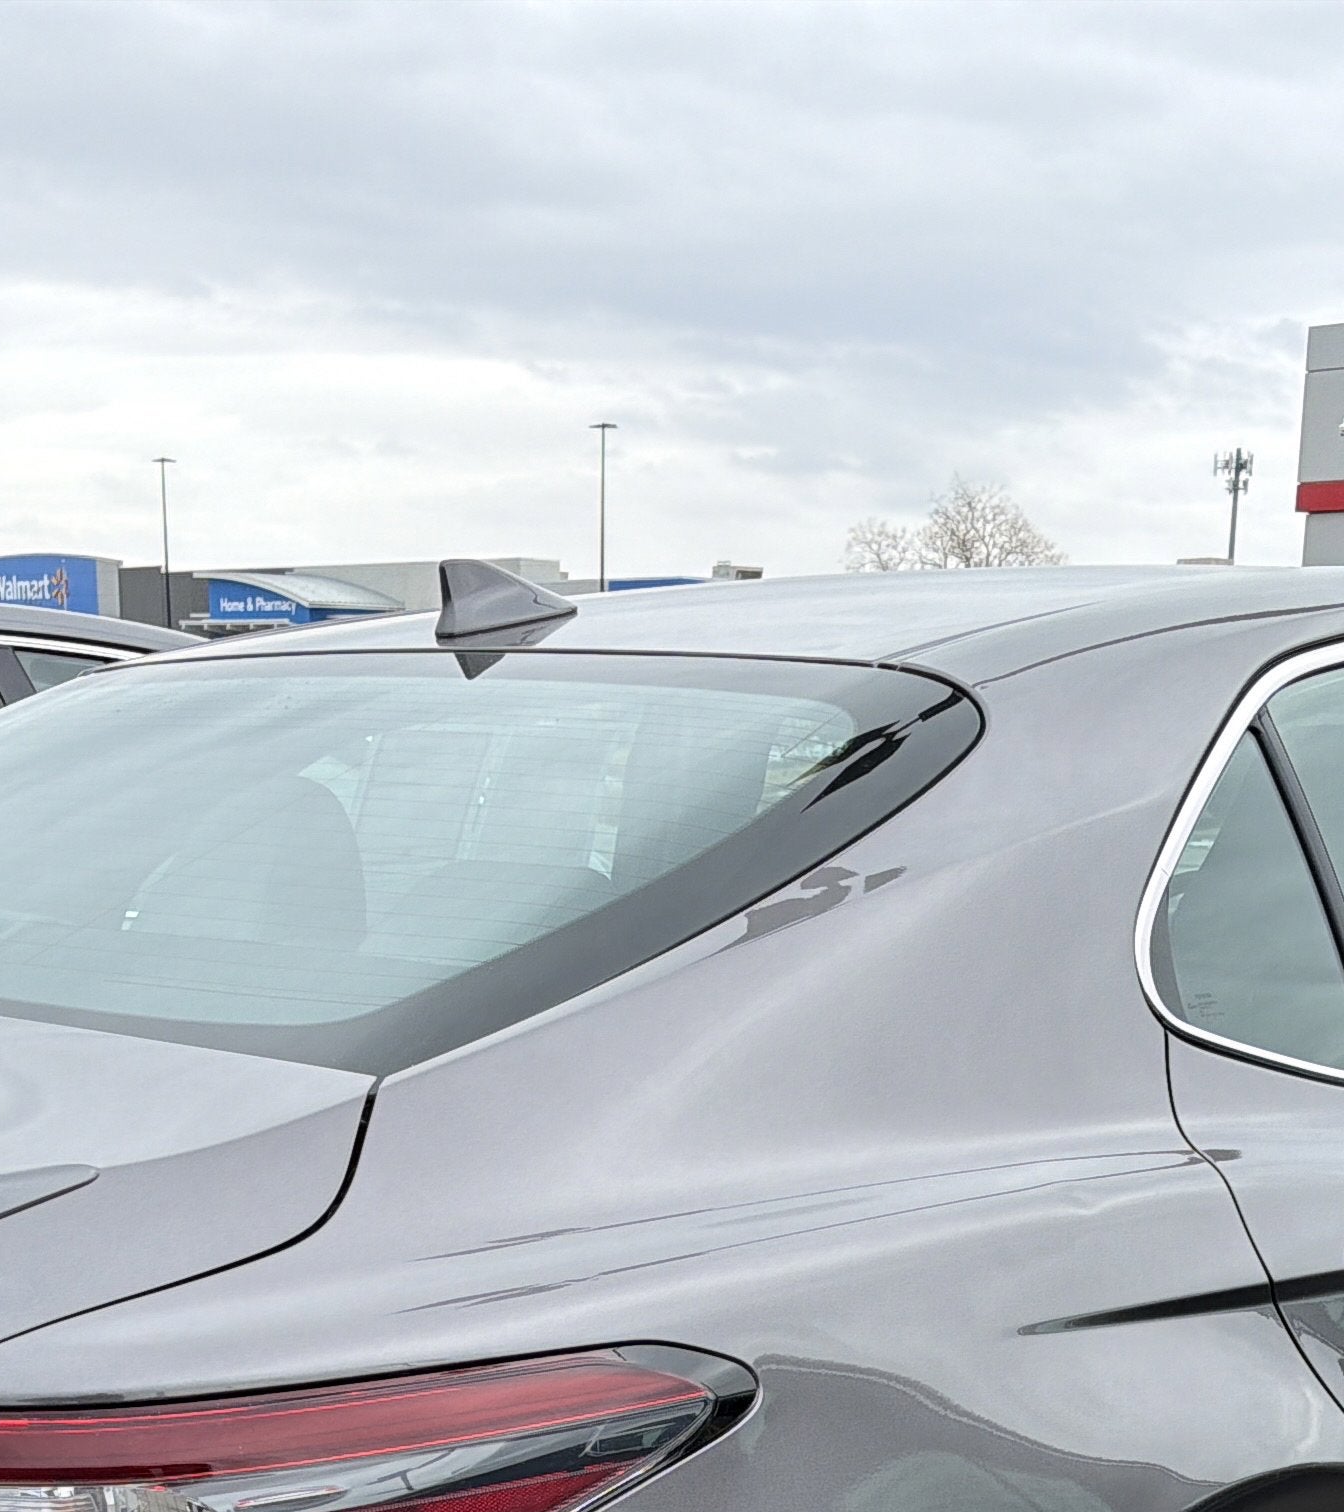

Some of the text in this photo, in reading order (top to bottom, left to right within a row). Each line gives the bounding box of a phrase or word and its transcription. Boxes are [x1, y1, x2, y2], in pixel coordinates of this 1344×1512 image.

[219, 597, 297, 616] Home & Pharmacy
